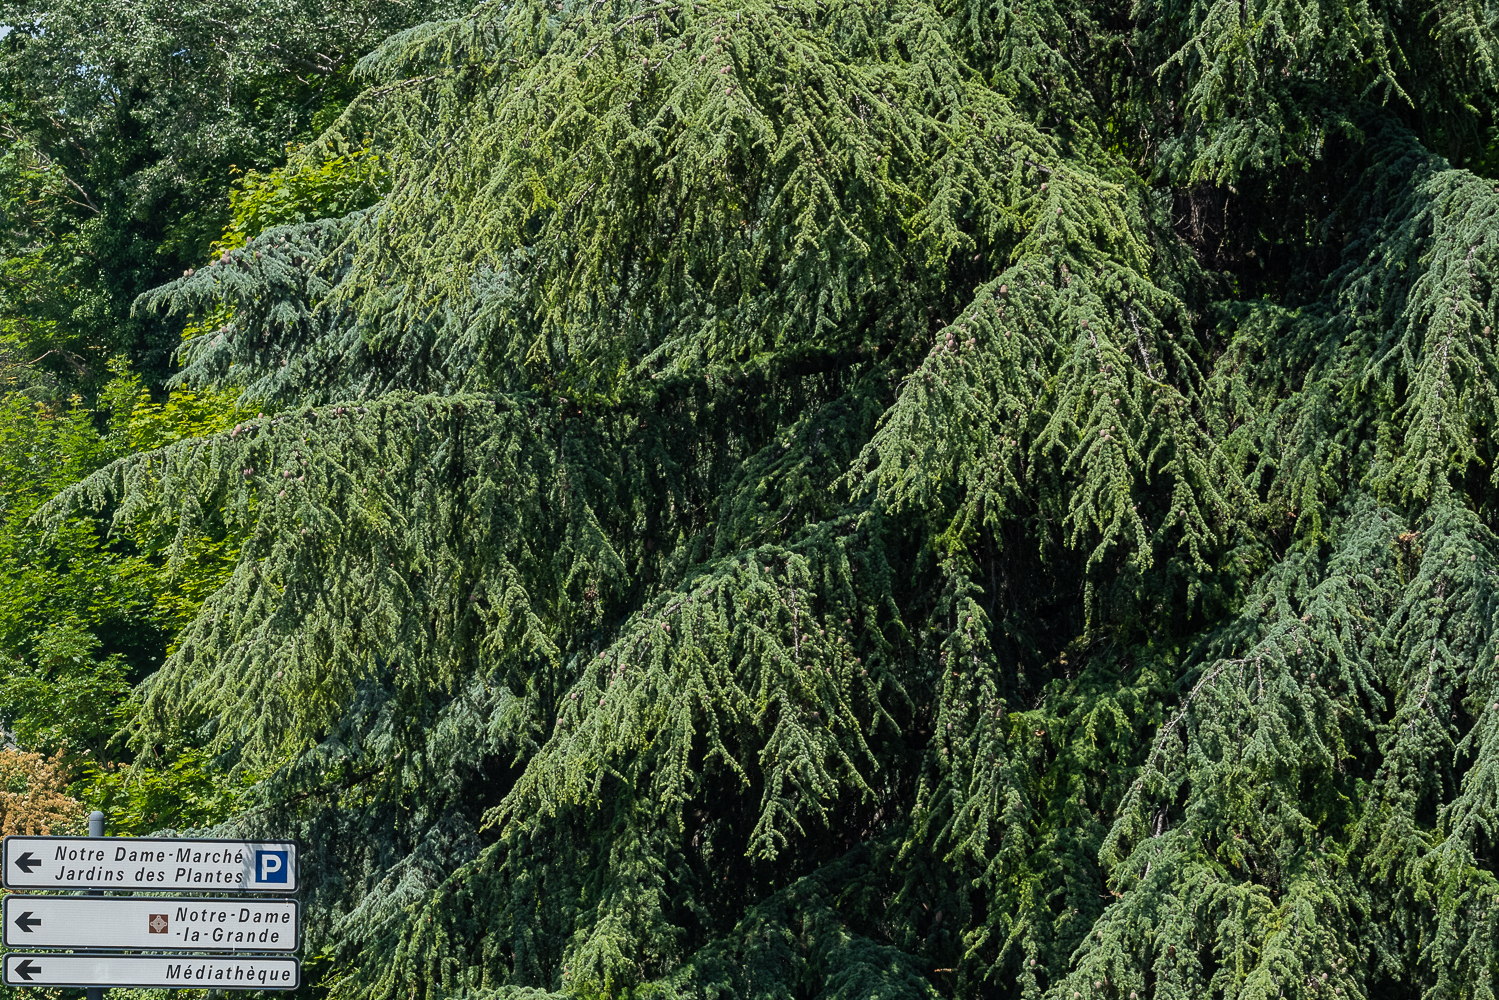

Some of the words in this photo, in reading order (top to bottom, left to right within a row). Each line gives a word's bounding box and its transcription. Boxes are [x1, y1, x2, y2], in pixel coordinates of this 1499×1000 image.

[54, 845, 105, 862] Notre
[114, 846, 244, 864] Dame-Marché
[54, 865, 125, 882] Jardins
[134, 866, 165, 883] des
[174, 867, 244, 884] Plantes
[260, 853, 283, 882] P
[175, 907, 291, 924] Notre-Dame
[176, 927, 280, 943] -la-Grande
[165, 964, 291, 985] Médiathèque
